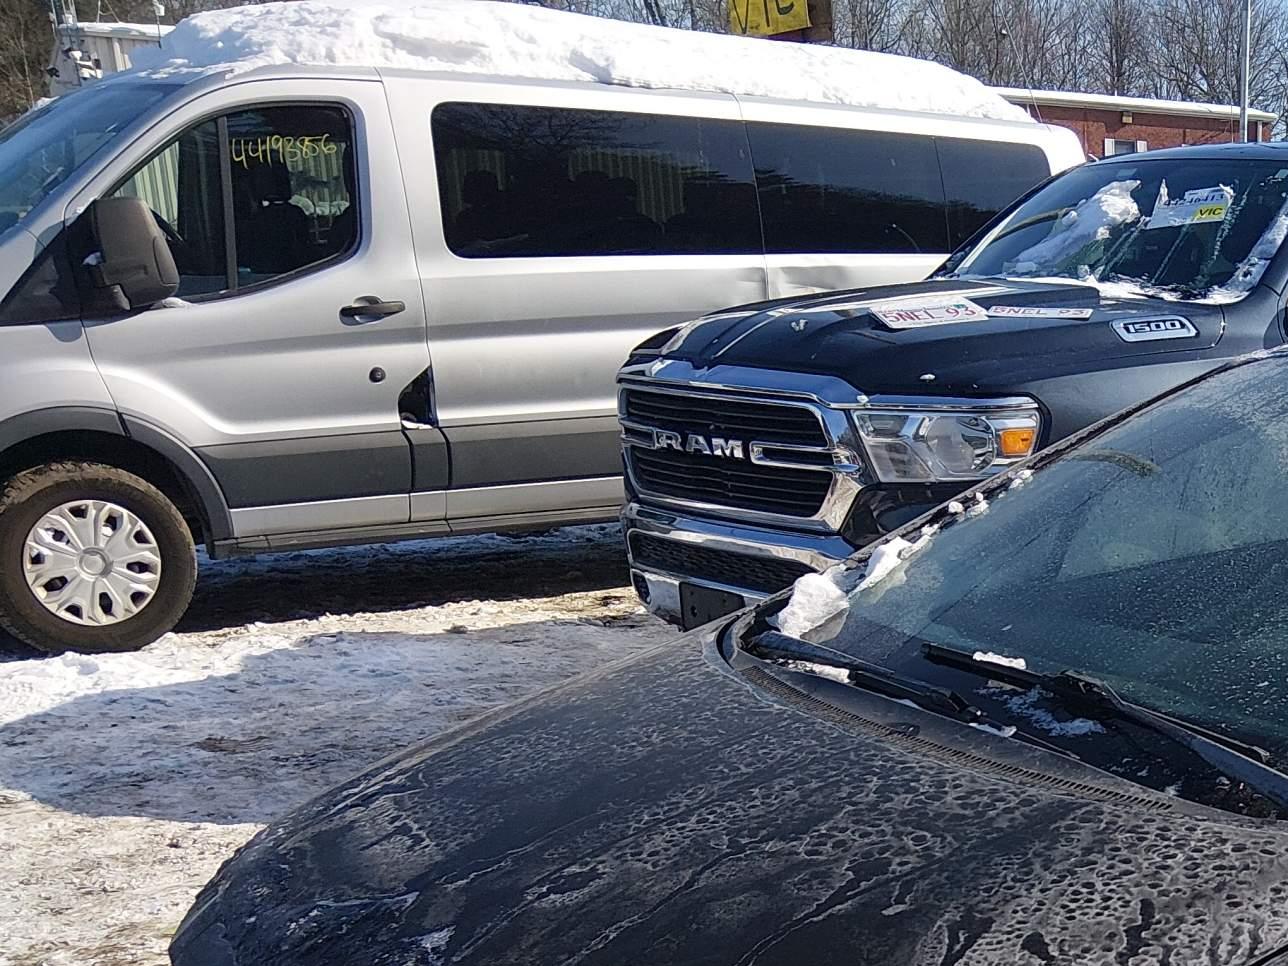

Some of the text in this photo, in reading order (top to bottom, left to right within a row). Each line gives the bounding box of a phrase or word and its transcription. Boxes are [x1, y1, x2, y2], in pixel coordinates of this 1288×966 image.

[232, 133, 337, 170] 44193856
[1199, 207, 1223, 217] VIC
[1125, 320, 1181, 333] 1500
[654, 429, 746, 459] RAM
